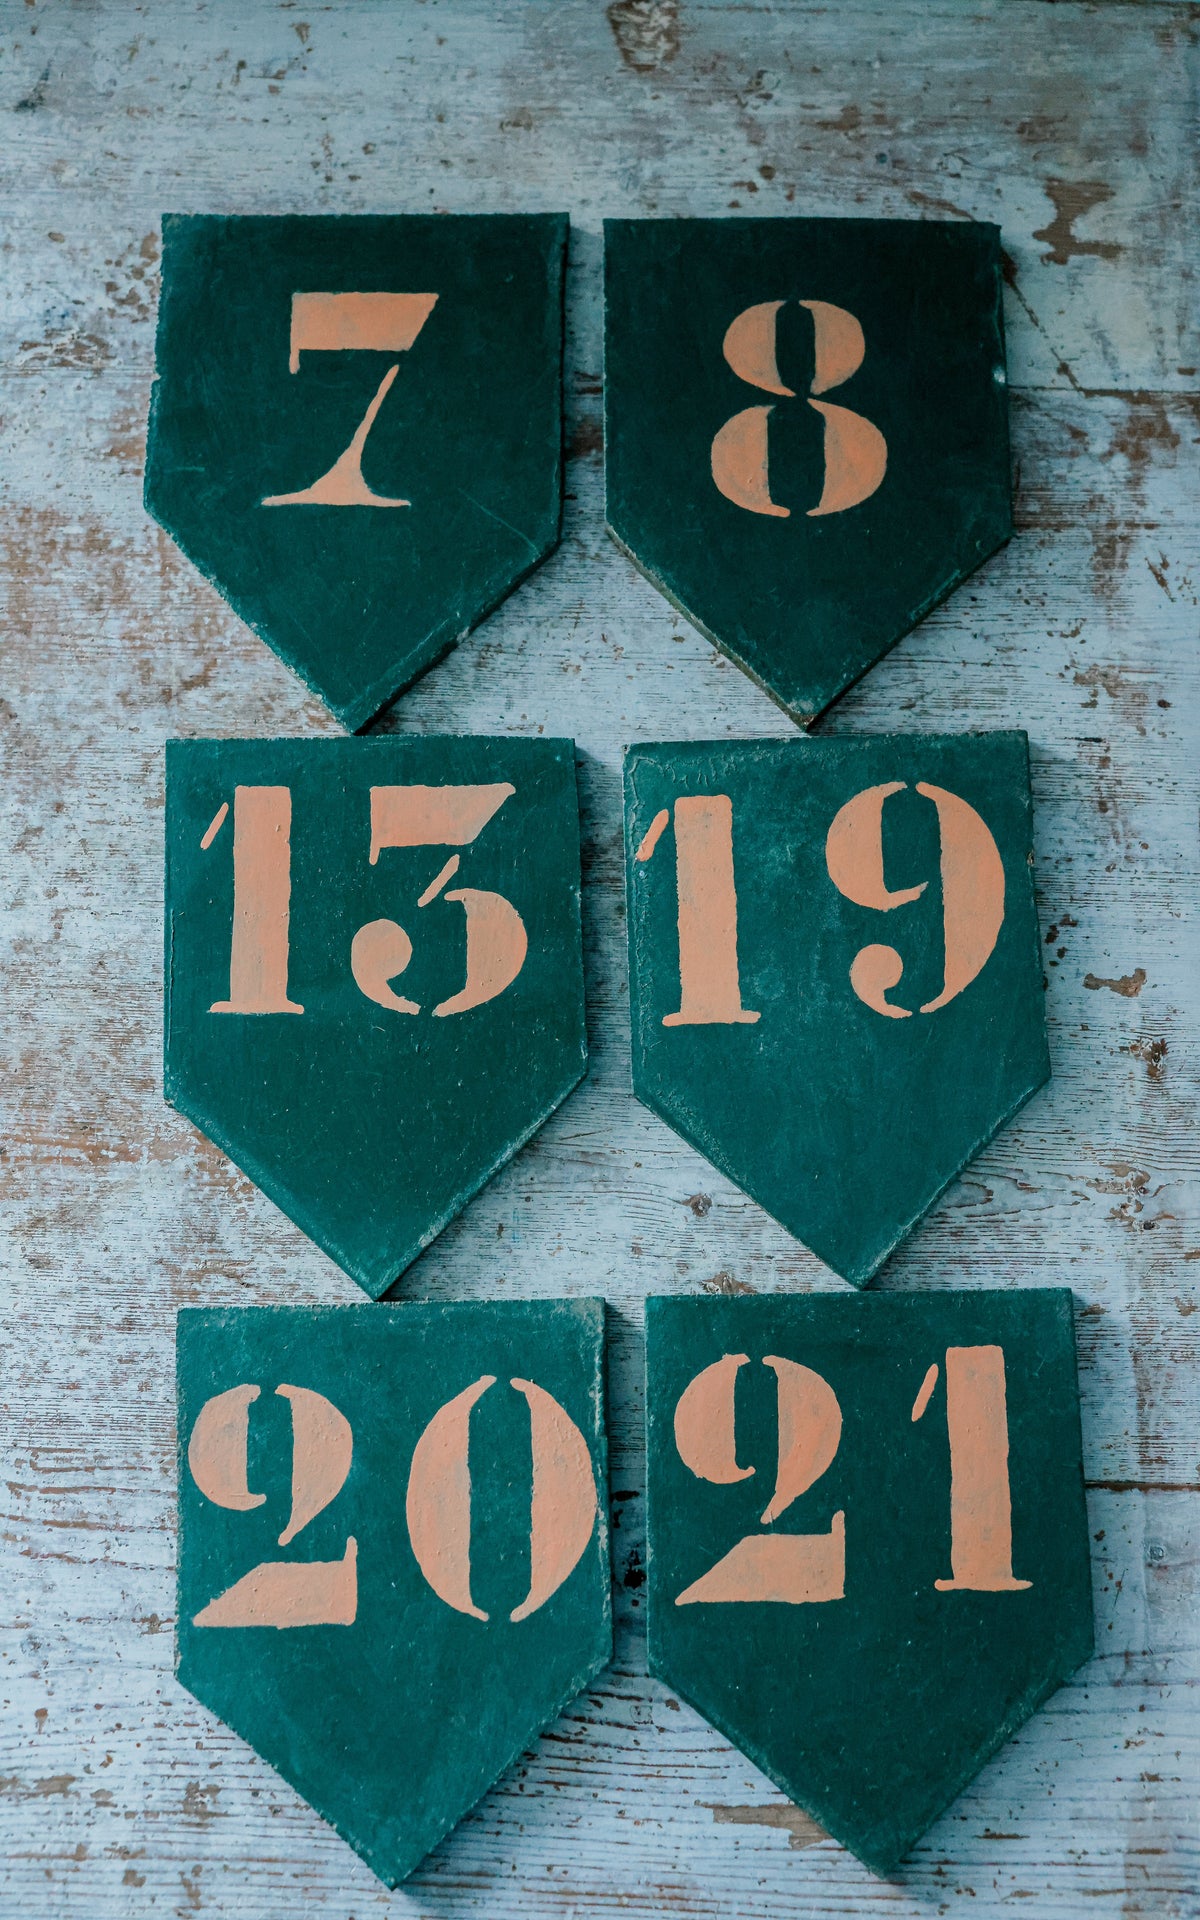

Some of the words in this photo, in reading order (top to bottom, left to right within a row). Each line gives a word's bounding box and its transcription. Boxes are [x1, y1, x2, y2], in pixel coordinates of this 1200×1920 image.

[261, 291, 439, 507] 7
[711, 299, 888, 517] 8
[200, 782, 528, 1017] 13
[635, 782, 1005, 1027] 19
[189, 1375, 598, 1629] 20
[673, 1344, 1033, 1606] 21
